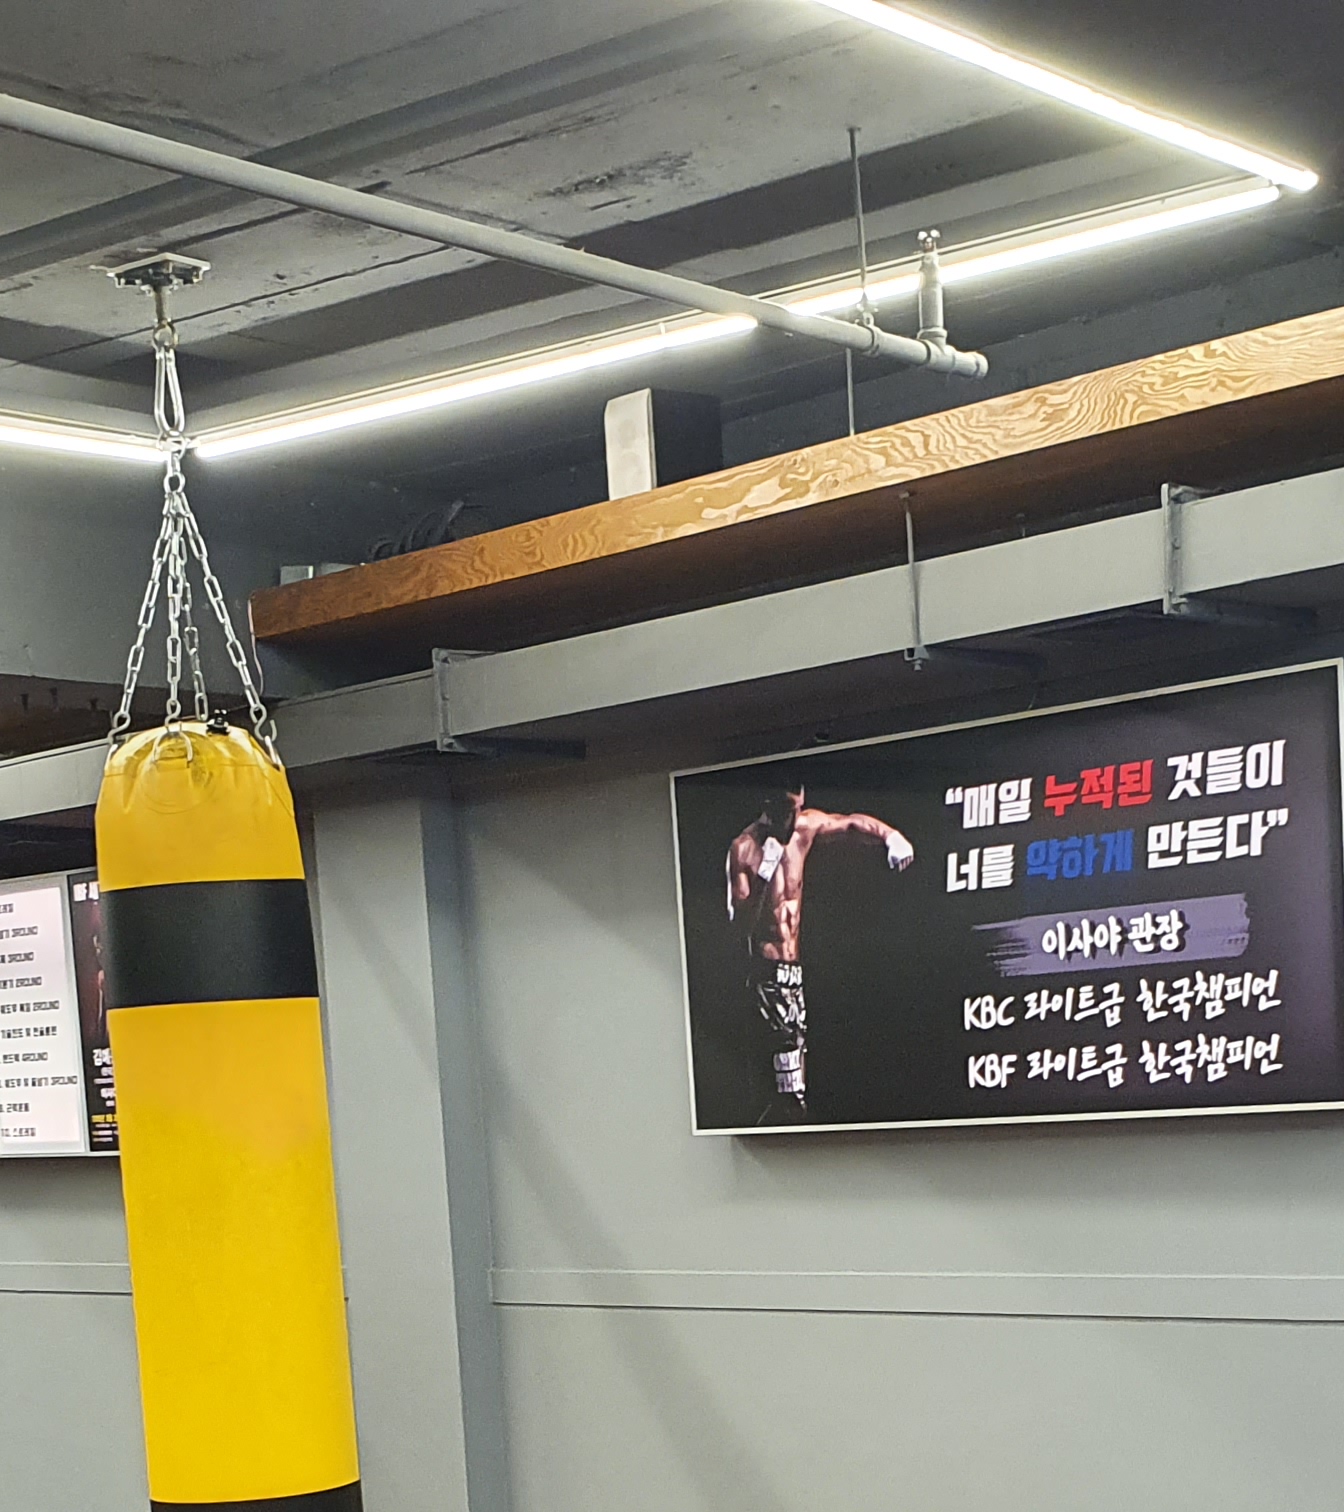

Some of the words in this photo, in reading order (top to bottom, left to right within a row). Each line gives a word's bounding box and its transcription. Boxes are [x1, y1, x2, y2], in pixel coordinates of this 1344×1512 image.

[1043, 759, 1154, 816] 누적된
[1167, 739, 1287, 800] 것들이
[946, 844, 1015, 893] 너를
[1041, 916, 1122, 960] 이사야
[1127, 909, 1183, 952] 관장
[963, 995, 1015, 1031] KBC
[1023, 982, 1125, 1028] 라이트급
[1136, 969, 1282, 1023] 한국챔피언
[968, 1053, 1017, 1089] KBF
[1027, 1043, 1127, 1089] 라이트급
[1138, 1033, 1284, 1084] 한국챔피언
